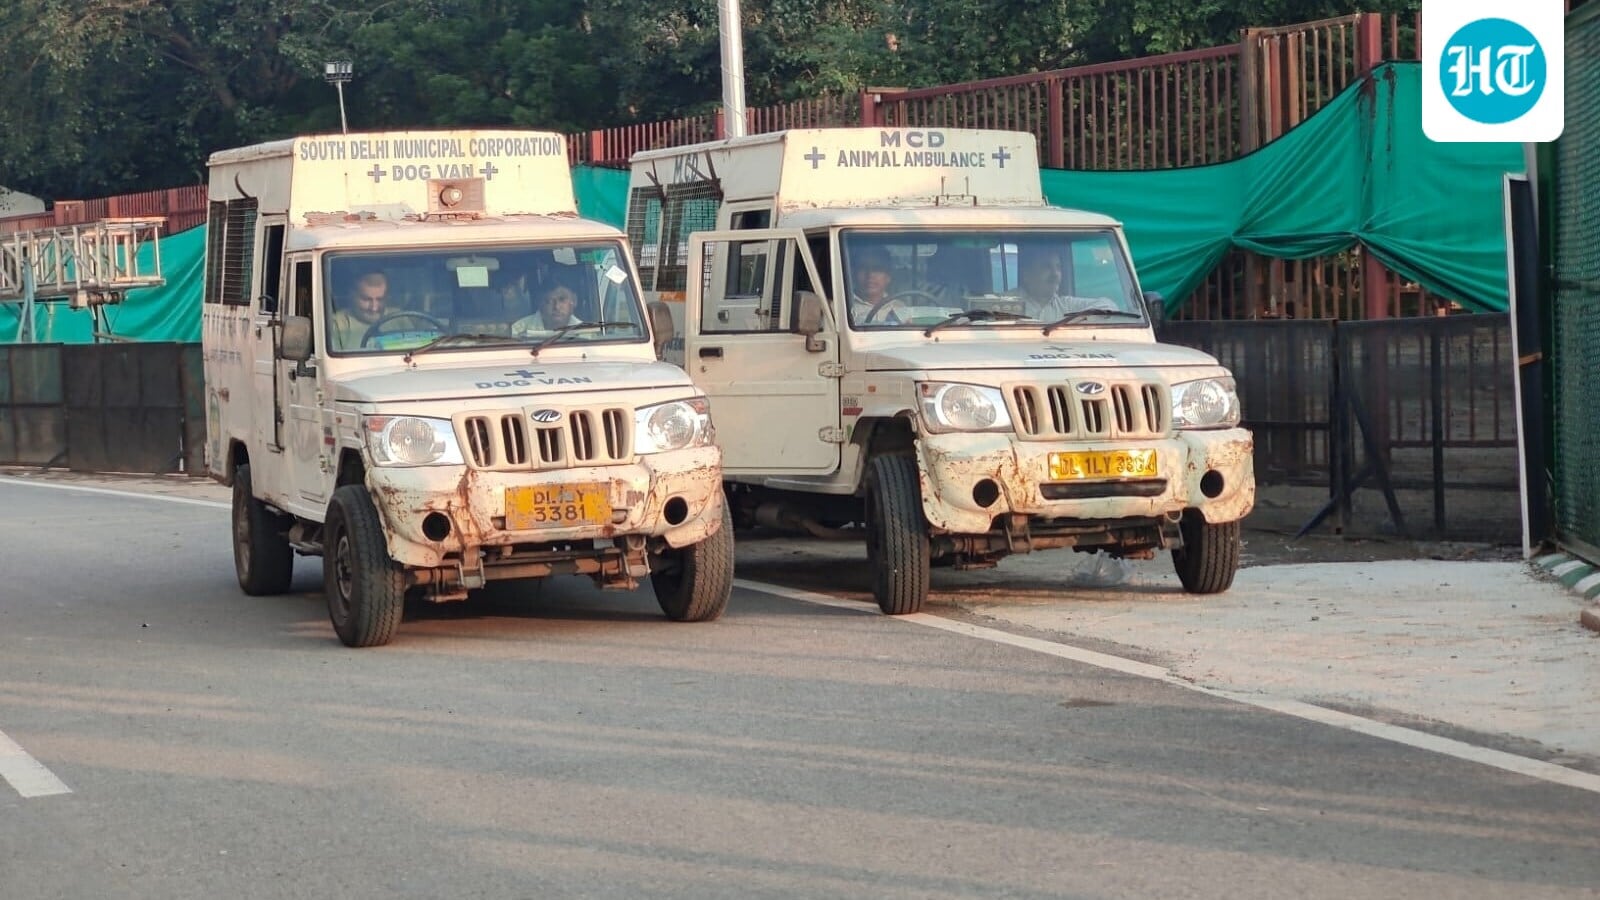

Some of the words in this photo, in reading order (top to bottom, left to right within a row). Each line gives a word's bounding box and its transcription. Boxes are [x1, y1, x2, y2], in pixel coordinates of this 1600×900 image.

[879, 130, 945, 148] MCD
[300, 140, 346, 161] SOUTH
[350, 139, 389, 160] DELHI
[393, 138, 466, 159] MUNICIPAL
[469, 136, 562, 158] CORPORATION
[837, 149, 901, 168] ANIMAL
[903, 151, 986, 168] AMBULANCE
[392, 164, 431, 181] DOG
[437, 163, 474, 179] VAN
[475, 380, 530, 389] DOG
[538, 377, 592, 385] VAN
[533, 504, 586, 522] 3381
